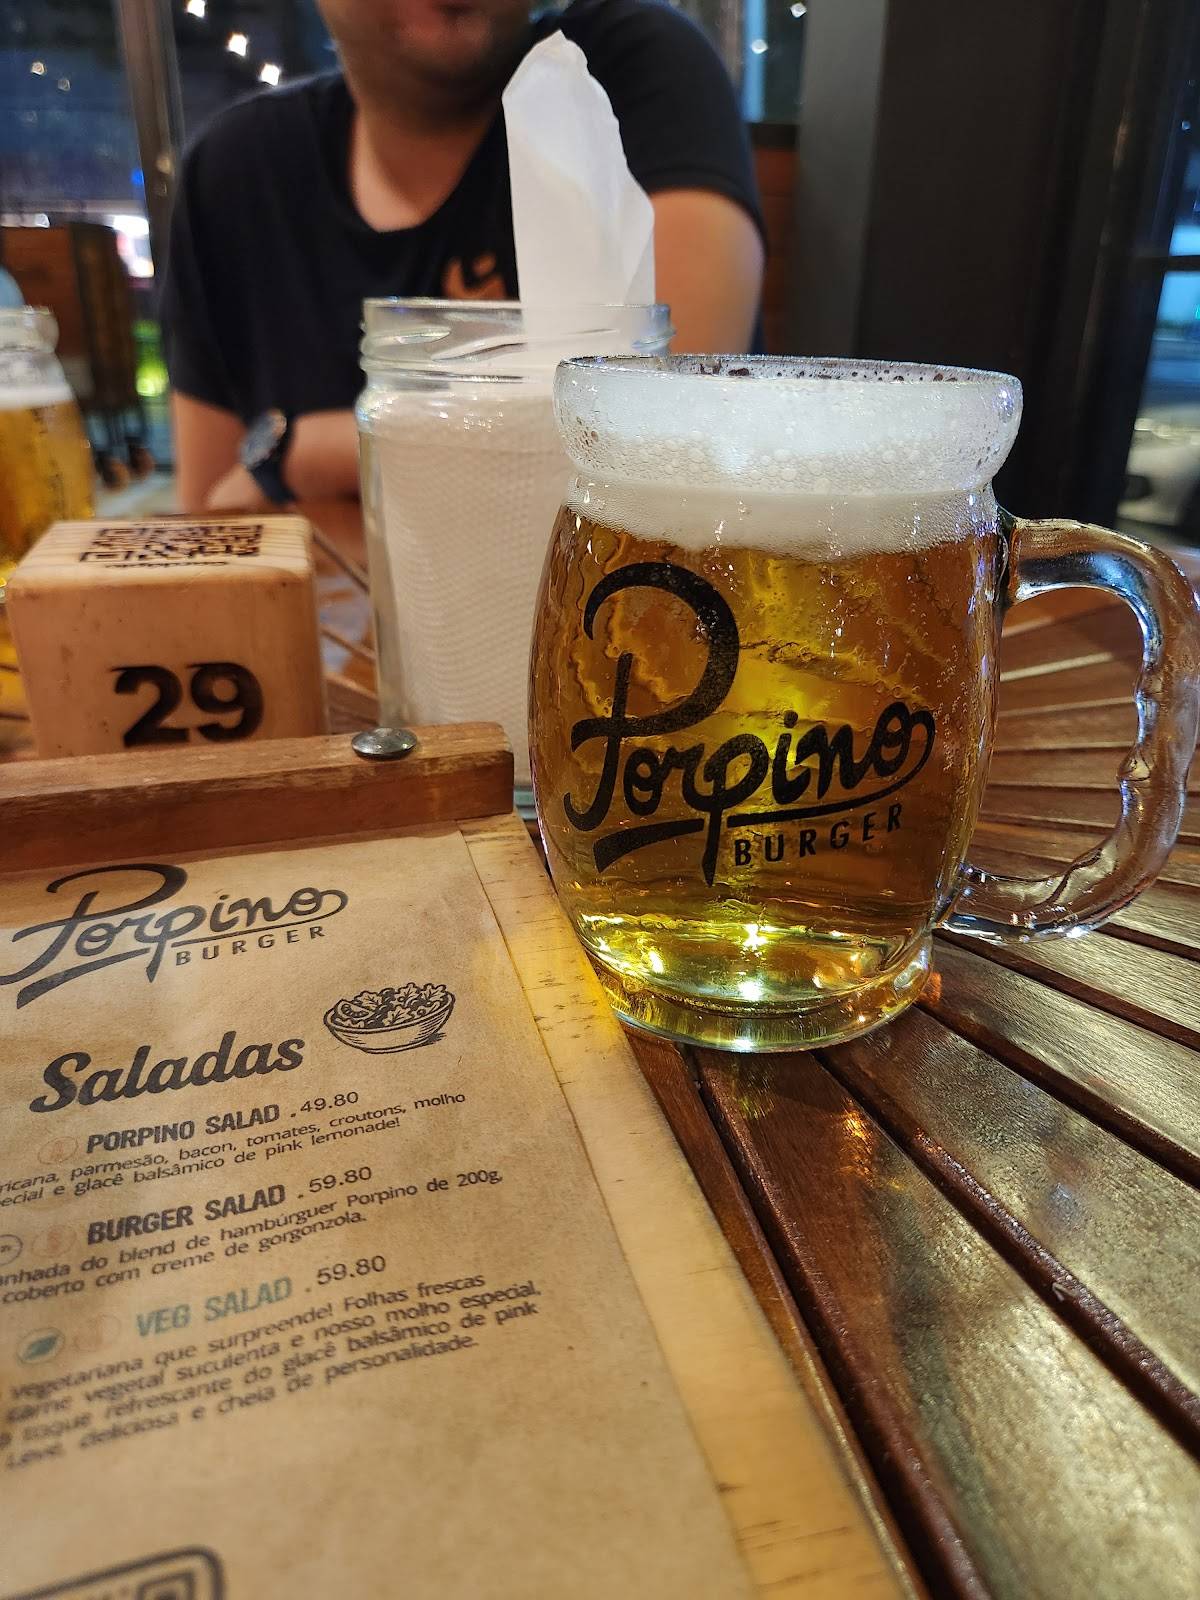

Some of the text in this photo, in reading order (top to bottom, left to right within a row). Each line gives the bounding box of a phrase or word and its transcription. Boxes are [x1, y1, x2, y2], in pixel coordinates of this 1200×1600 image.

[108, 662, 264, 748] 29
[563, 561, 936, 888] Porpino
[734, 803, 903, 867] BURGER
[0, 863, 349, 1009] Porpino
[175, 926, 326, 966] BURGER
[29, 1030, 306, 1113] Saladas
[53, 1185, 65, 1196] e
[74, 1174, 124, 1196] glacê
[133, 1157, 225, 1182] balsâmico
[234, 1150, 256, 1164] de
[265, 1139, 303, 1160] pink
[311, 1117, 401, 1145] lemonade!
[70, 1154, 169, 1181] parmesão,
[179, 1142, 238, 1161] bacon,
[247, 1123, 321, 1147] tomates,
[329, 1104, 407, 1128] croutons,
[414, 1092, 466, 1110] molho
[86, 1090, 359, 1154] PORPINO SALAD 49.80
[80, 1255, 108, 1271] do
[119, 1241, 176, 1263] blend
[186, 1234, 210, 1250] de
[220, 1201, 338, 1241] hambúrguer
[347, 1184, 418, 1207] Porpino
[426, 1177, 449, 1192] de
[87, 1166, 372, 1245] BURGER SALAD 59.80
[3, 1211, 367, 1303] coberto com creme de gorgonzola.
[136, 1255, 387, 1337] VEG SALAD 59.80
[154, 1345, 197, 1369] que
[207, 1302, 333, 1353] surpreende!
[343, 1288, 409, 1312] Folhas
[417, 1274, 486, 1298] frescas
[175, 1341, 280, 1381] suculenta
[290, 1333, 304, 1348] e
[314, 1314, 376, 1340] nosso
[385, 1301, 450, 1323] molho
[243, 1366, 273, 1384] do
[281, 1341, 336, 1377] glacê
[347, 1321, 450, 1353] balsâmico
[460, 1312, 486, 1329] de
[494, 1301, 540, 1325] pink
[217, 1385, 275, 1414] cheia
[286, 1372, 313, 1393] de
